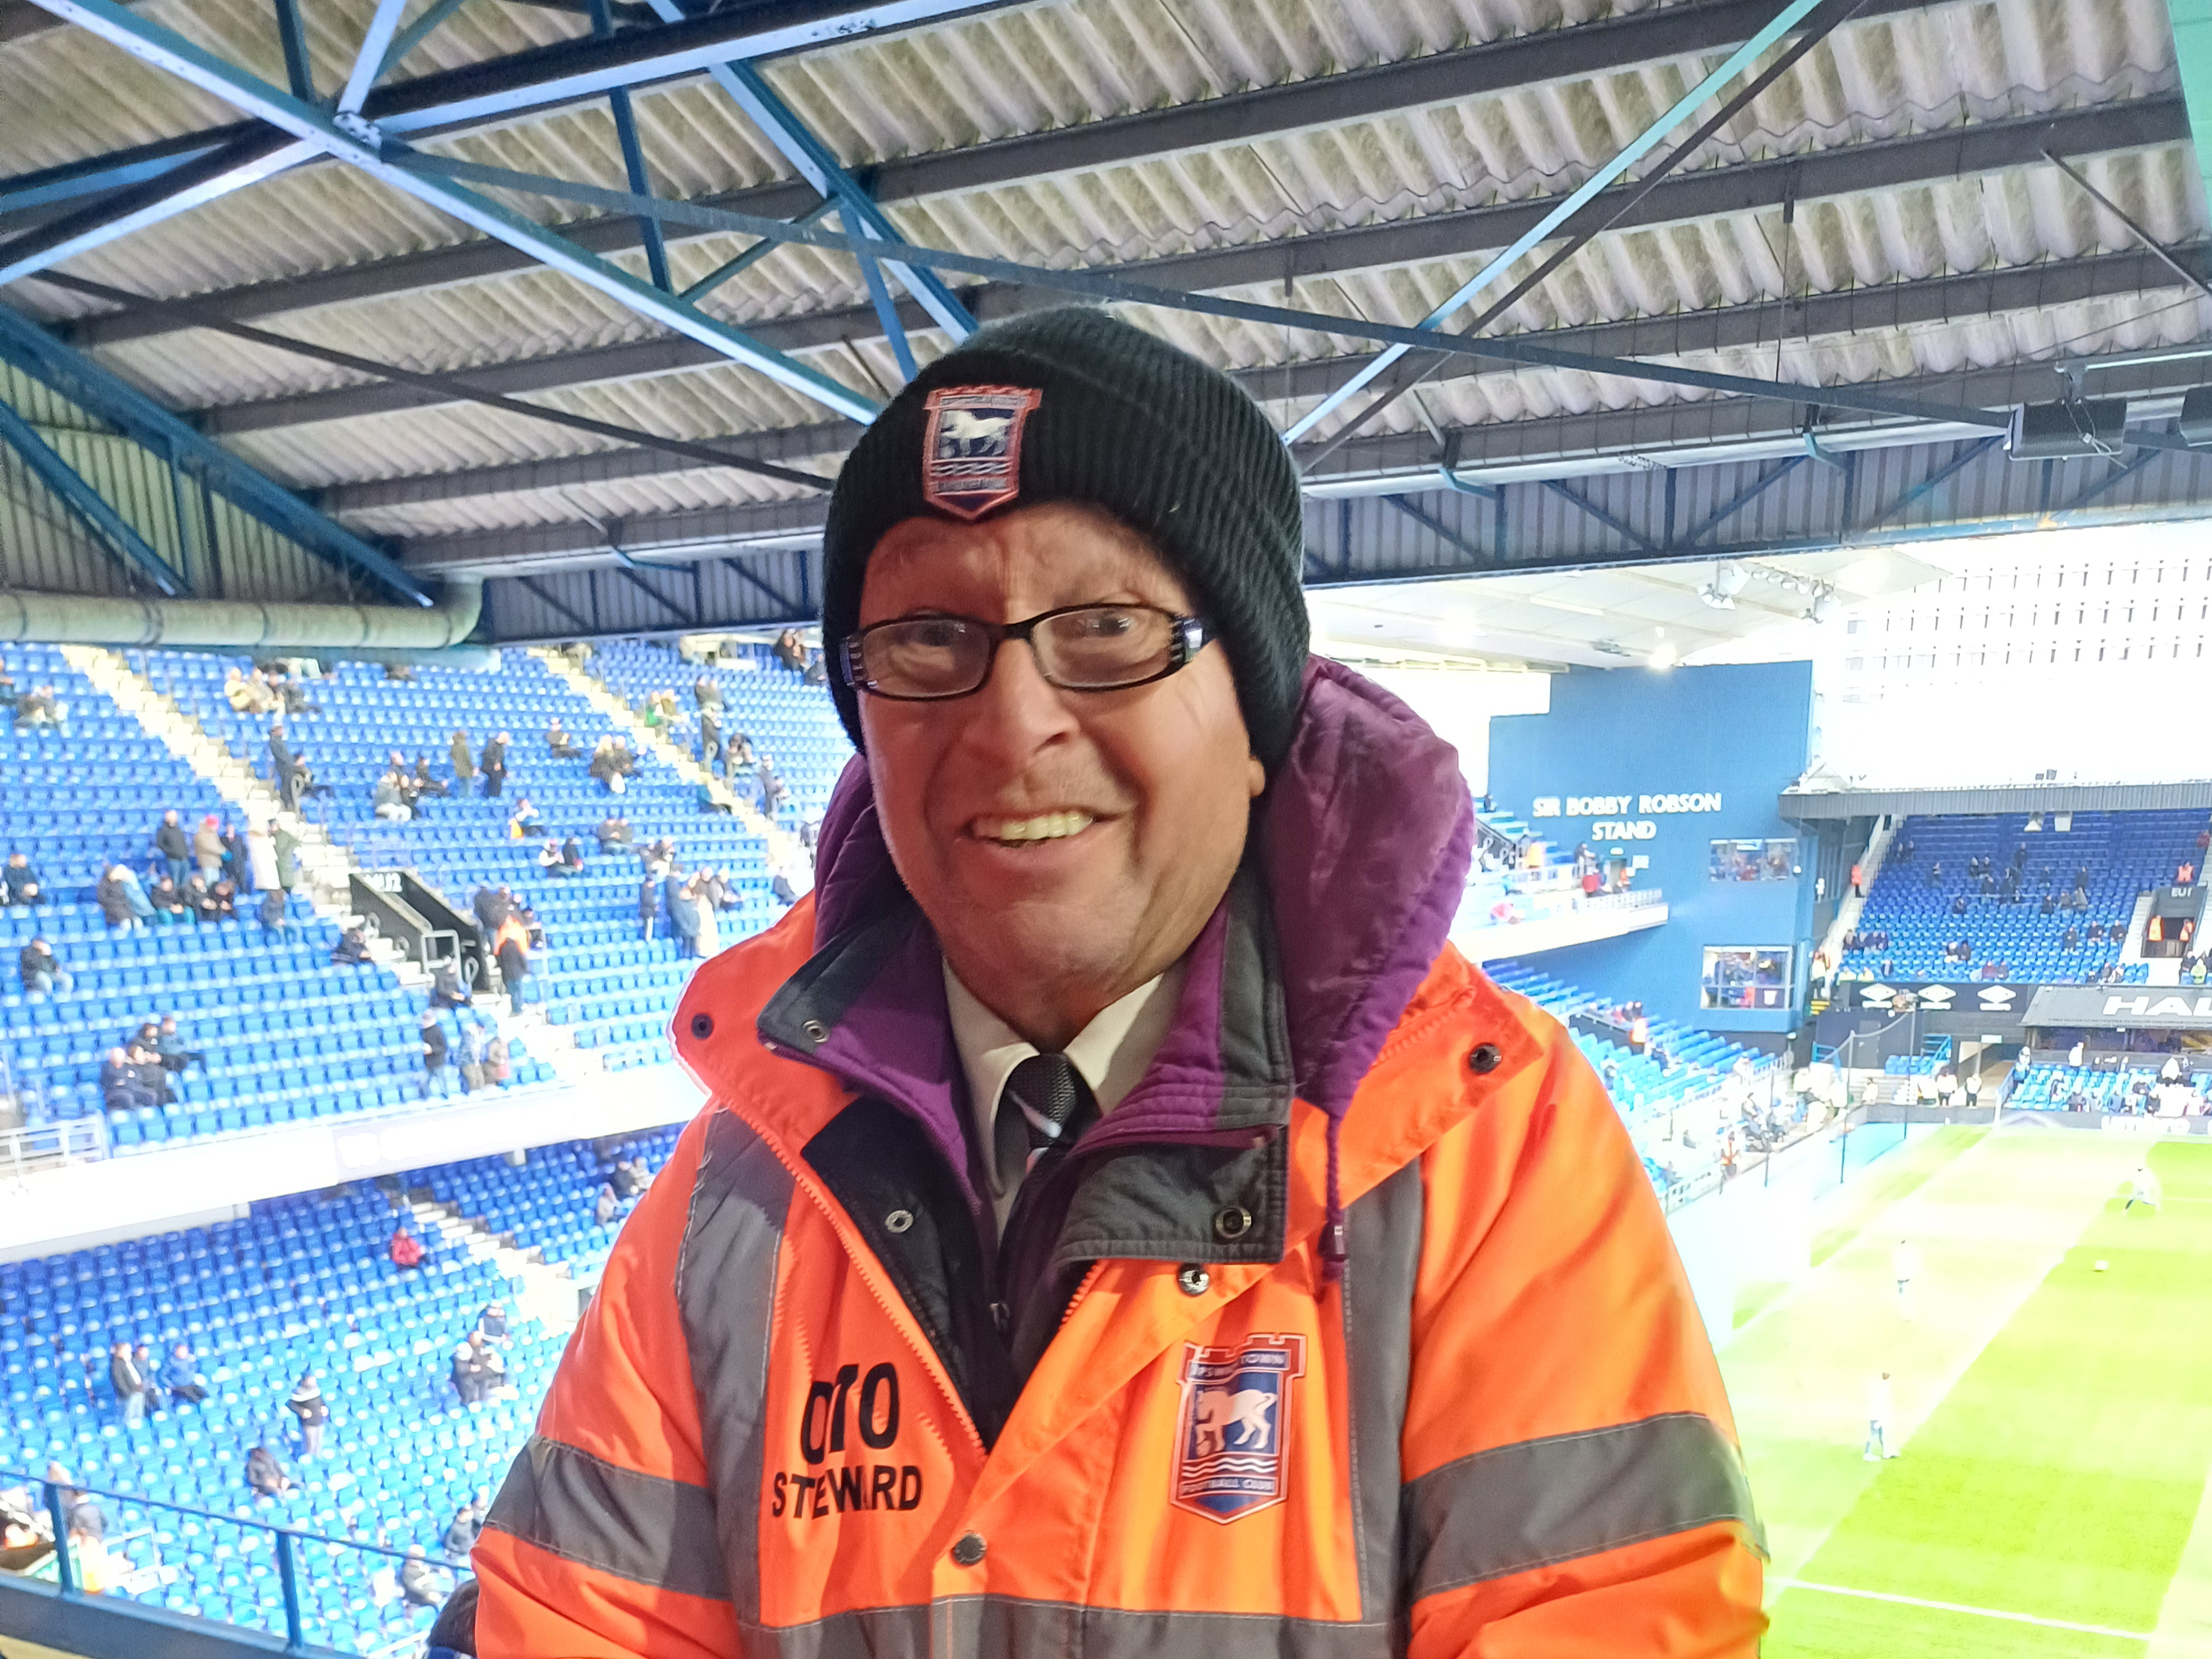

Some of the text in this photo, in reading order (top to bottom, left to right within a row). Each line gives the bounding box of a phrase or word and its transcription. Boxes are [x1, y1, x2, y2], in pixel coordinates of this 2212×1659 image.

[1532, 793, 1722, 817] SIR BOBBY ROBSON
[1591, 821, 1657, 841] STAND
[772, 1464, 922, 1520] STEWRD
